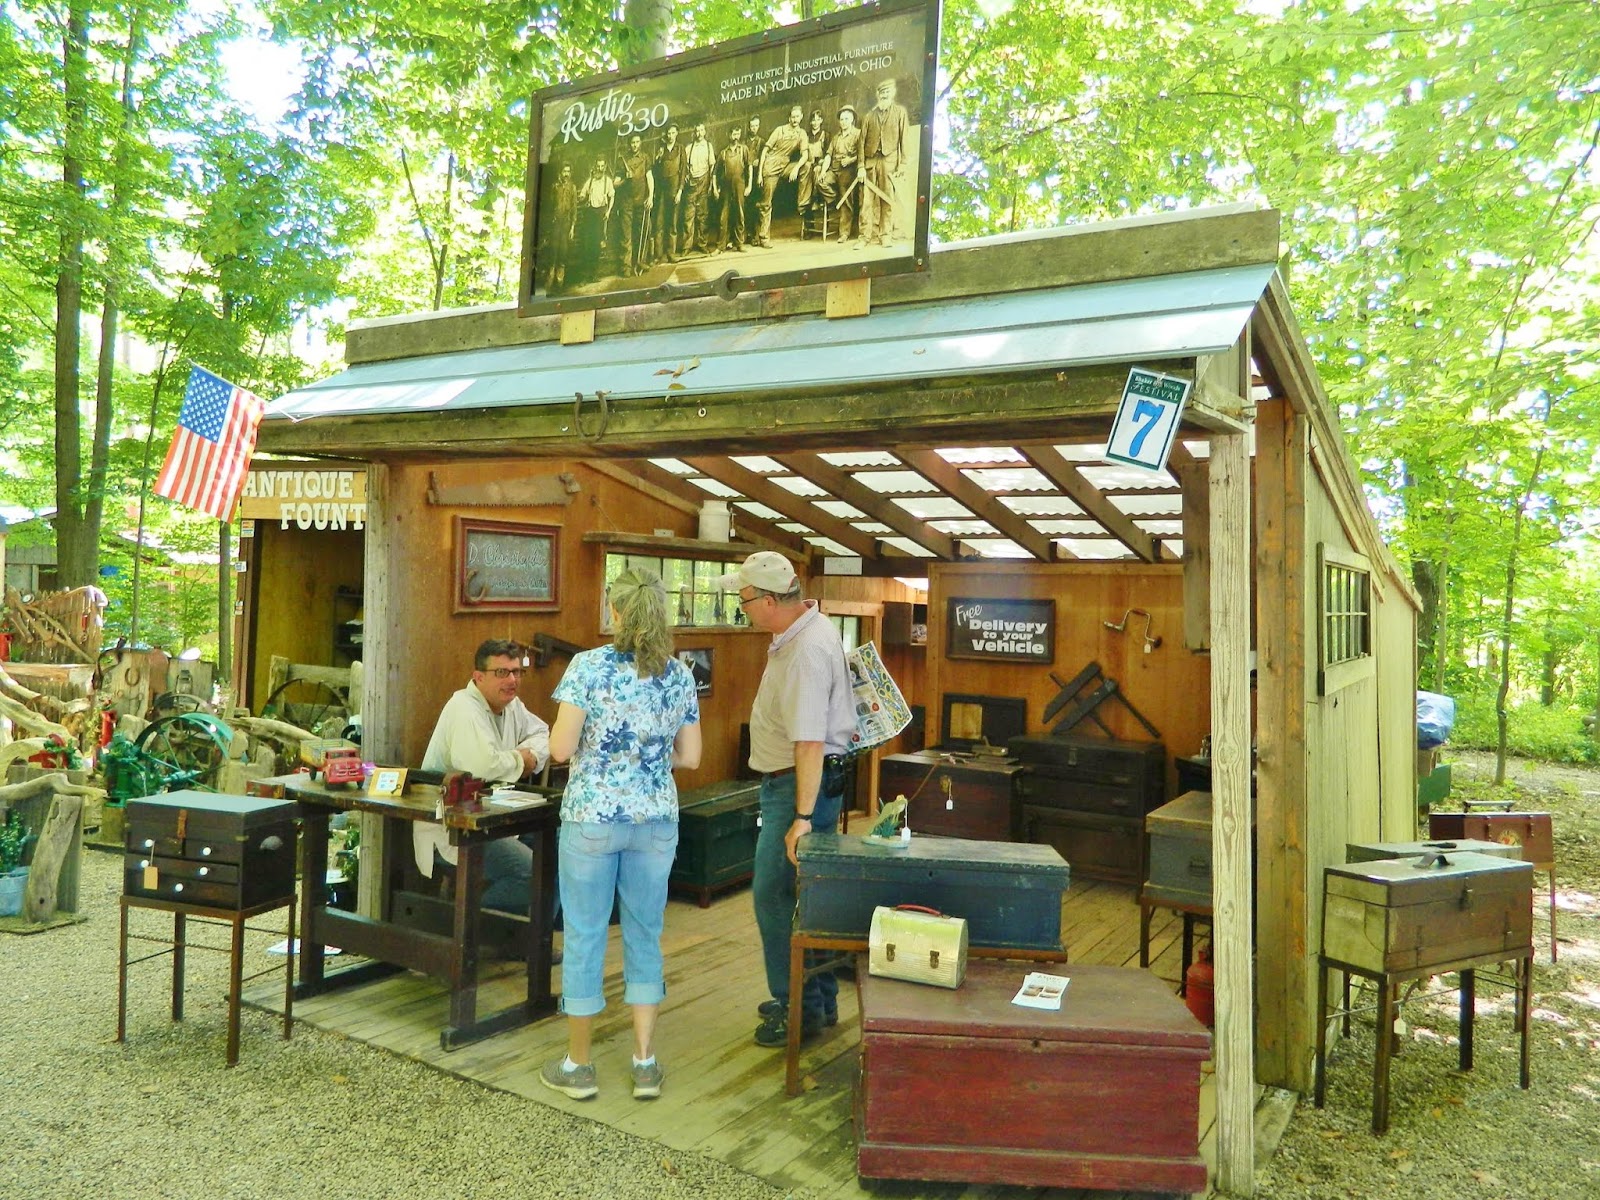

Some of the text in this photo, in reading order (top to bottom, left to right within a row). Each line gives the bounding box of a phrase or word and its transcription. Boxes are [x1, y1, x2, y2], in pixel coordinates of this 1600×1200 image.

[720, 41, 894, 89] QUALITY RUSTIC & INDUSTRIAL FURNITURE
[720, 55, 892, 104] MADE IN YOUNGSTOWN, OHIO
[561, 88, 636, 144] Rustic
[617, 103, 669, 136] 330
[1130, 381, 1179, 401] FESTIVAL
[1129, 399, 1165, 457] 7
[241, 470, 354, 499] ANTIQUE
[280, 502, 367, 531] FOUNT
[955, 604, 983, 626] Free
[969, 619, 1048, 635] Delivery
[971, 639, 1045, 655] Vehicle
[982, 630, 1034, 641] to your
